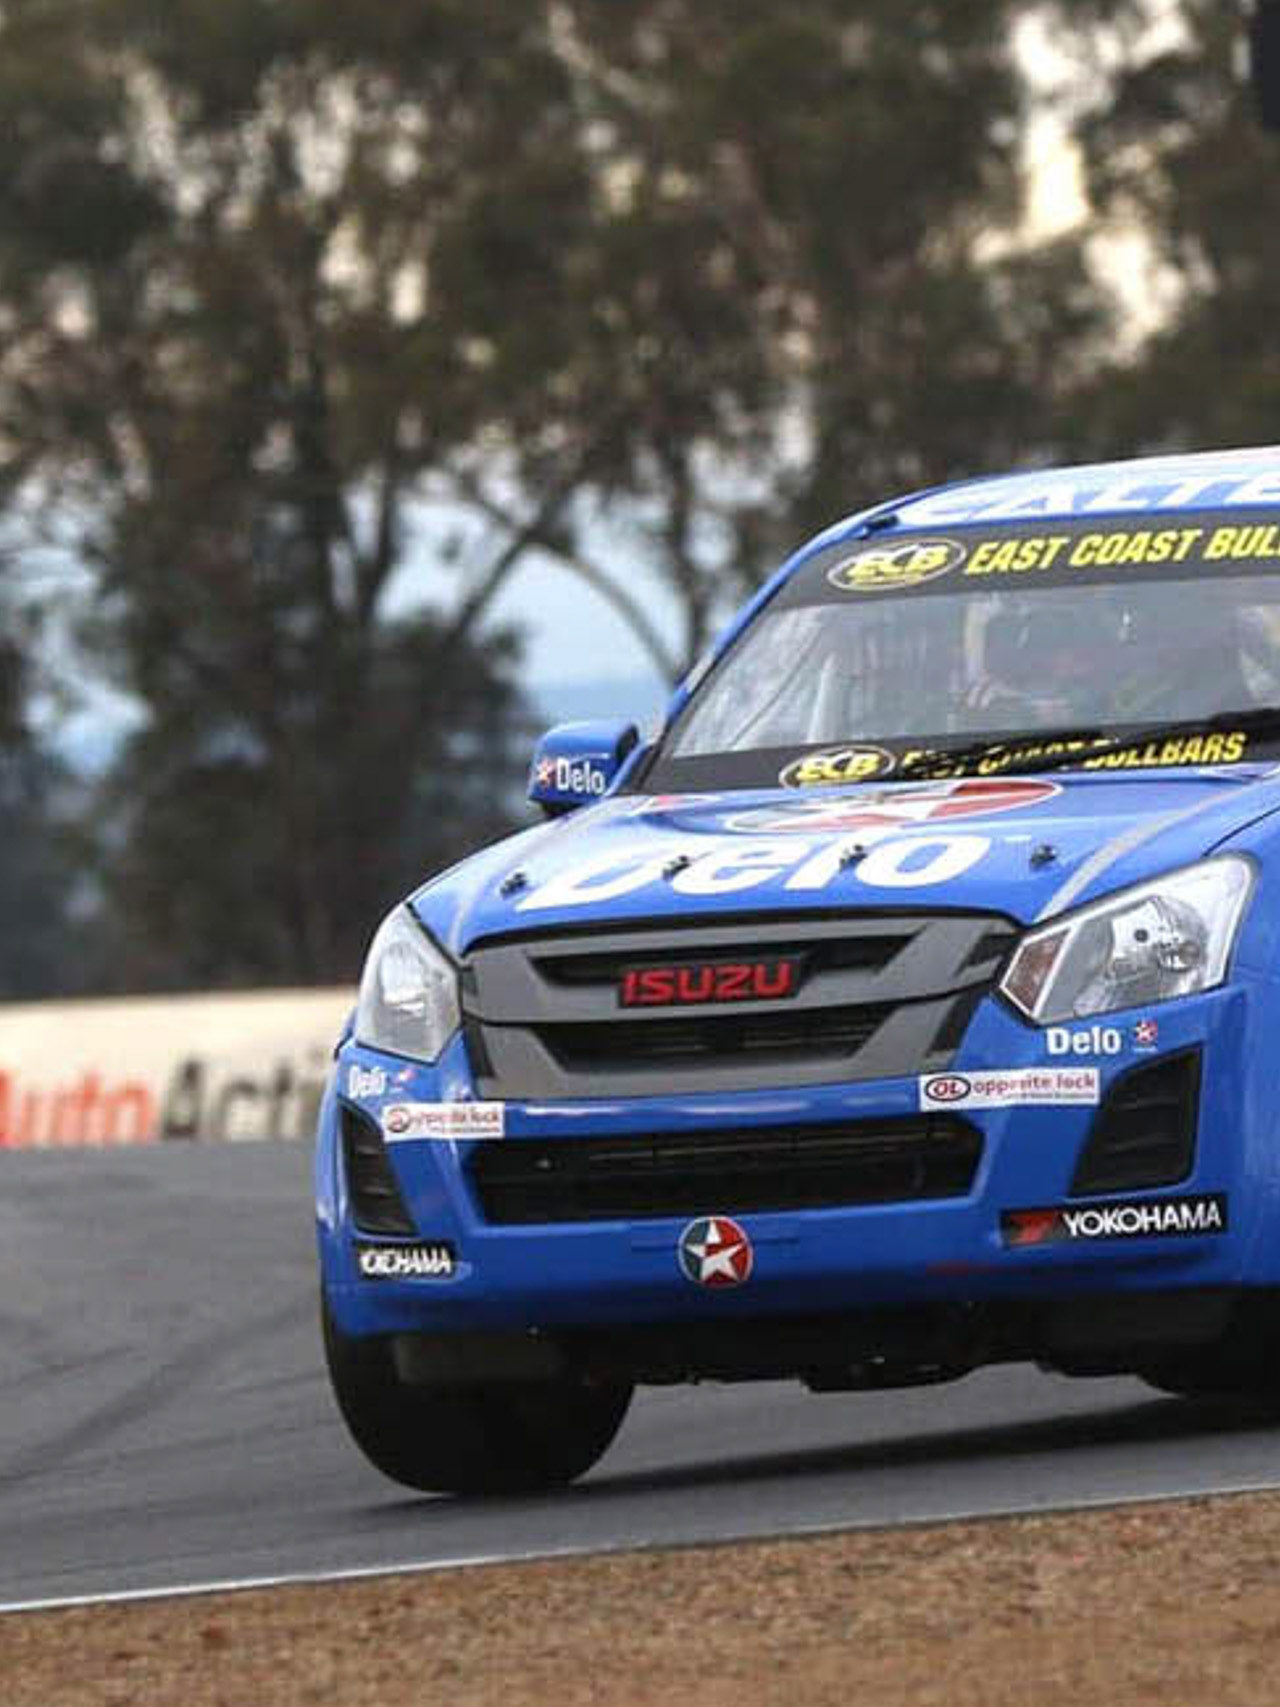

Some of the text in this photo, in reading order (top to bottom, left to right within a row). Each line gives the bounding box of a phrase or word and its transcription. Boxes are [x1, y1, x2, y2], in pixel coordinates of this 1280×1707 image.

[964, 536, 1070, 576] EAST
[1068, 529, 1204, 567] COAST
[556, 757, 605, 794] Delo
[796, 743, 884, 784] ECB
[514, 835, 991, 911] Delo
[623, 963, 793, 1004] ISUZU
[1047, 1027, 1122, 1055] Delo
[973, 1073, 1051, 1095] opposite
[1056, 1072, 1095, 1091] lock
[1063, 1202, 1222, 1236] YOKOHAMA
